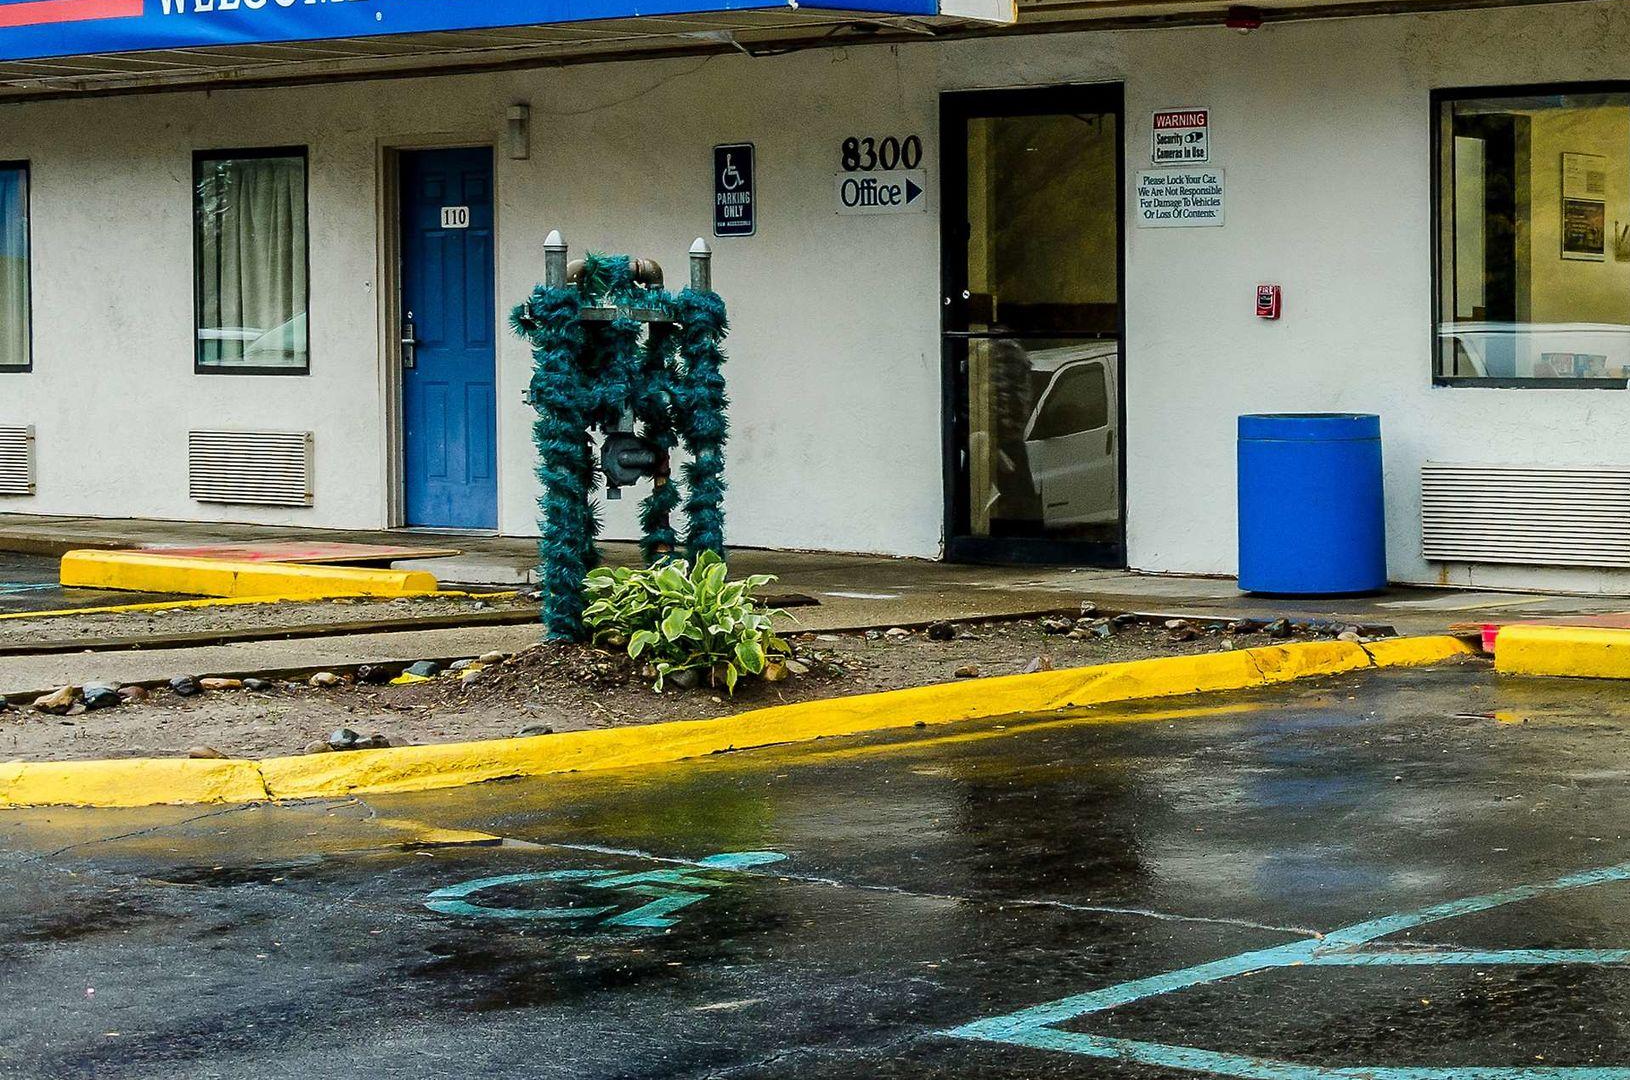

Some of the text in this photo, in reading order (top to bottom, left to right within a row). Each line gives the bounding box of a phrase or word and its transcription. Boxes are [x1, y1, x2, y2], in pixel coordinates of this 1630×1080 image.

[1156, 113, 1205, 127] WARNING
[1156, 133, 1183, 146] Security
[841, 135, 923, 172] 8300
[1156, 146, 1204, 159] Cameras In Use
[1143, 176, 1165, 186] Please
[1167, 175, 1184, 185] Lock
[1185, 175, 1201, 184] Your
[717, 191, 750, 205] PARKING
[841, 178, 901, 207] Office
[1138, 185, 1222, 198] We Are Not Responsible
[1140, 197, 1221, 209] For Damage To Vehicles
[444, 209, 466, 225] 110
[724, 205, 743, 218] ONLY
[1144, 210, 1155, 219] Or
[1156, 209, 1171, 219] Loss
[1172, 208, 1182, 219] Of
